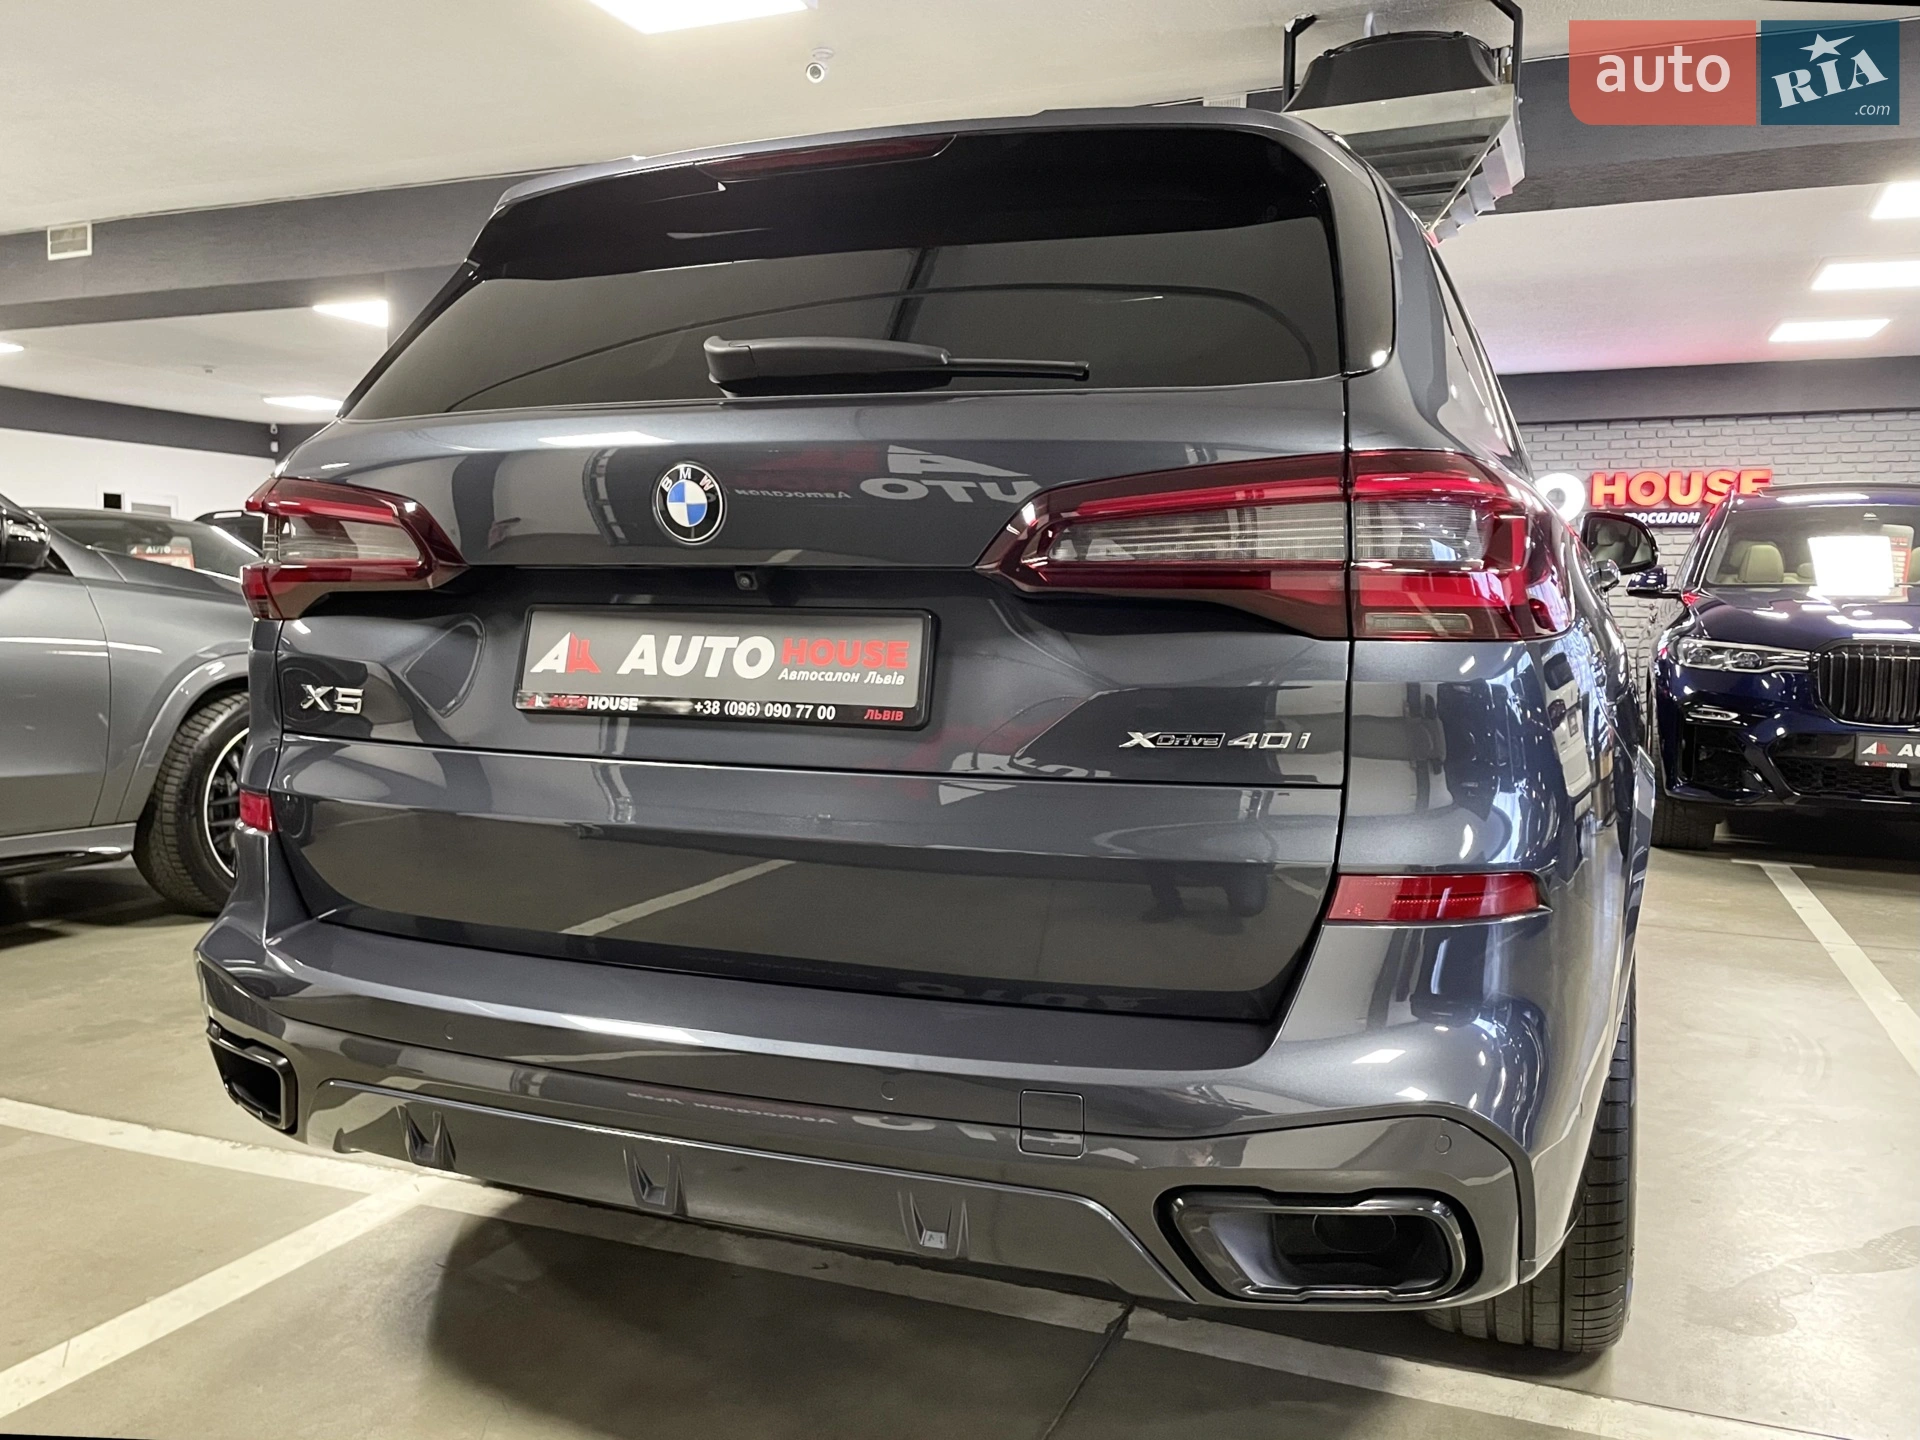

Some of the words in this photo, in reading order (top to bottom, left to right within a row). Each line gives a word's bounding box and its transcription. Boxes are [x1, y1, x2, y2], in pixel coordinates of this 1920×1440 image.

[660, 467, 715, 493] BMW
[1591, 469, 1773, 506] HOUSE
[1624, 511, 1701, 525] осалон
[616, 634, 776, 680] AUTO
[781, 638, 910, 669] HOUSE
[777, 667, 861, 683] Автосалон
[863, 671, 906, 686] Львів
[300, 684, 366, 714] X5
[694, 700, 721, 715] +38
[724, 701, 761, 717] (096)
[764, 702, 791, 718] 090
[795, 704, 814, 719] 77
[817, 705, 836, 720] 00
[863, 708, 904, 721] ЛЬВІВ
[1227, 732, 1312, 749] 40i
